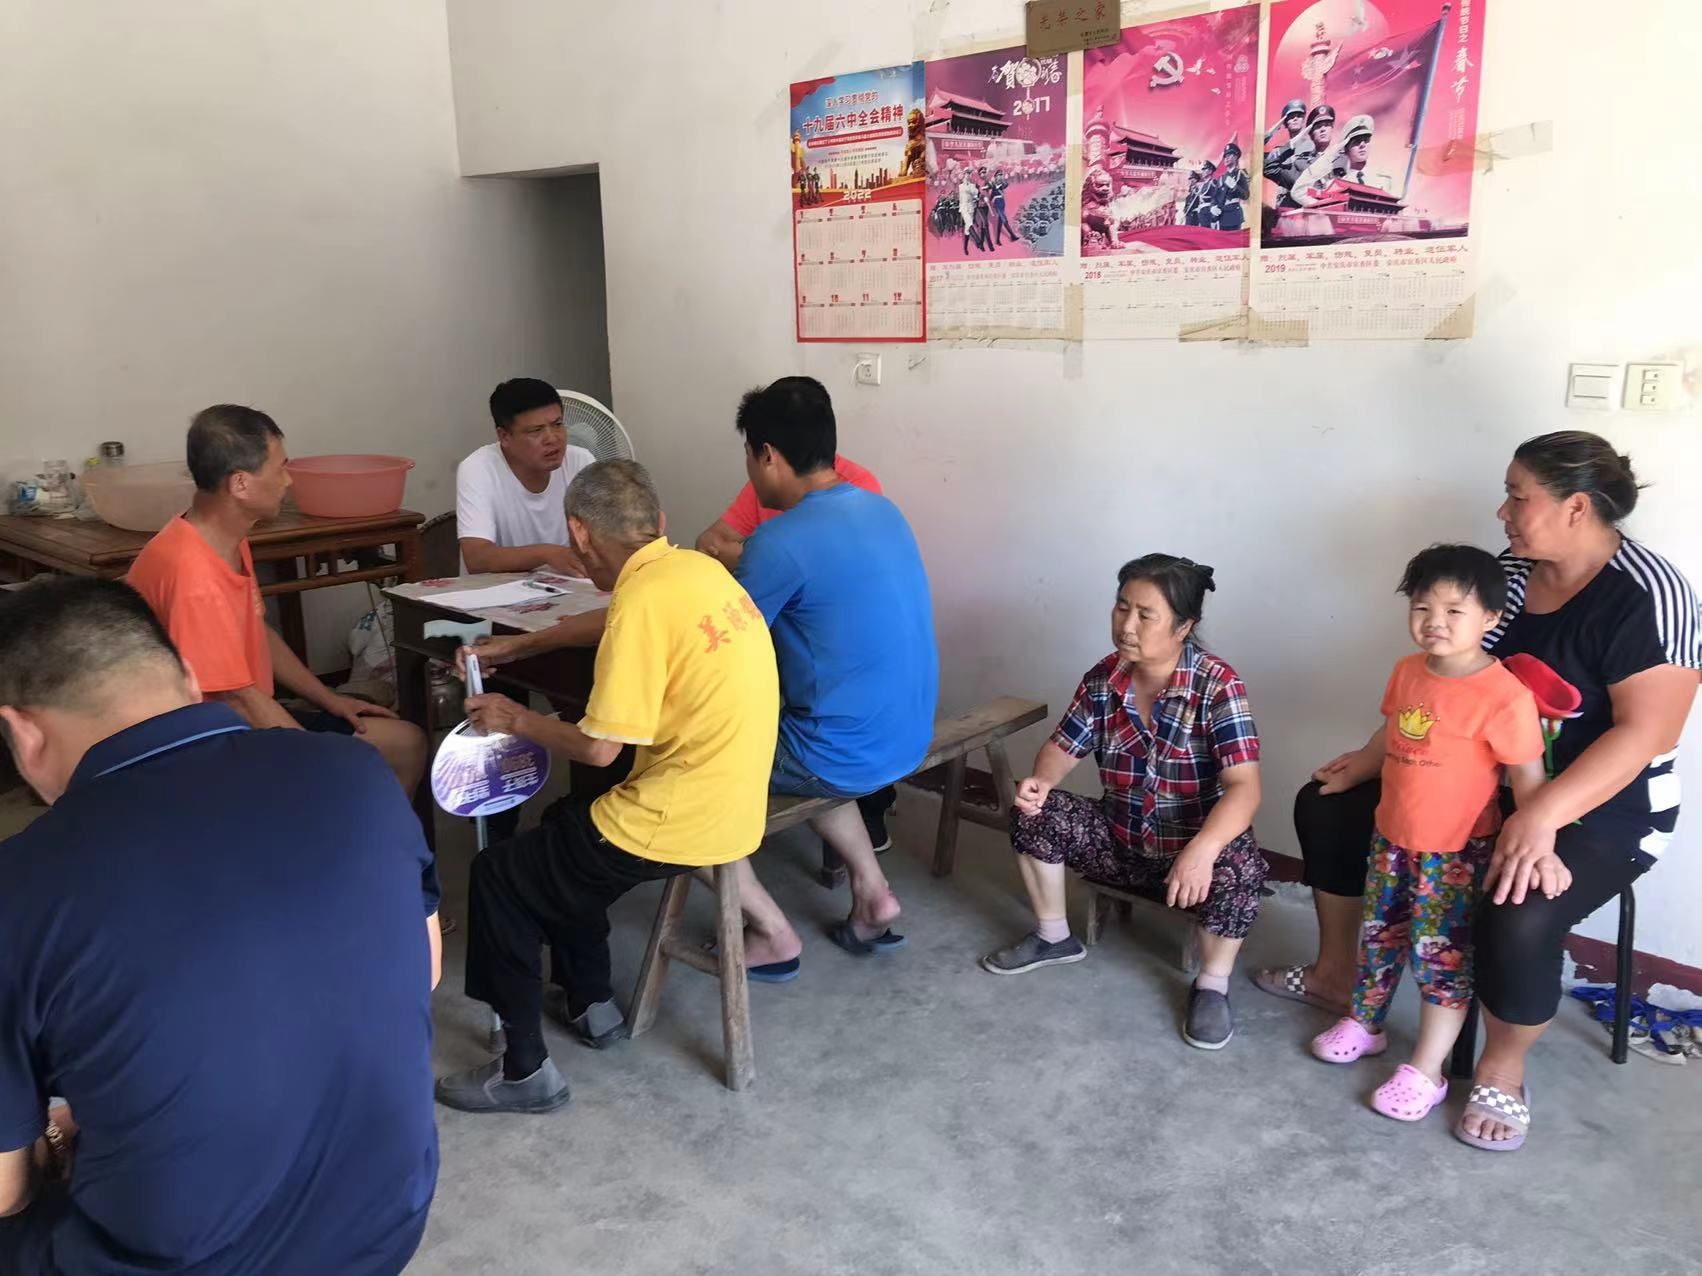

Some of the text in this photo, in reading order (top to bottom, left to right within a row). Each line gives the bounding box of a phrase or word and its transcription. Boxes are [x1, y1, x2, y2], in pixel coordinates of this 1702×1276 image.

[1013, 96, 1050, 117] 2017
[803, 104, 904, 135] 十九届六中全会精神
[843, 189, 872, 201] 2022
[1265, 264, 1286, 273] 2019
